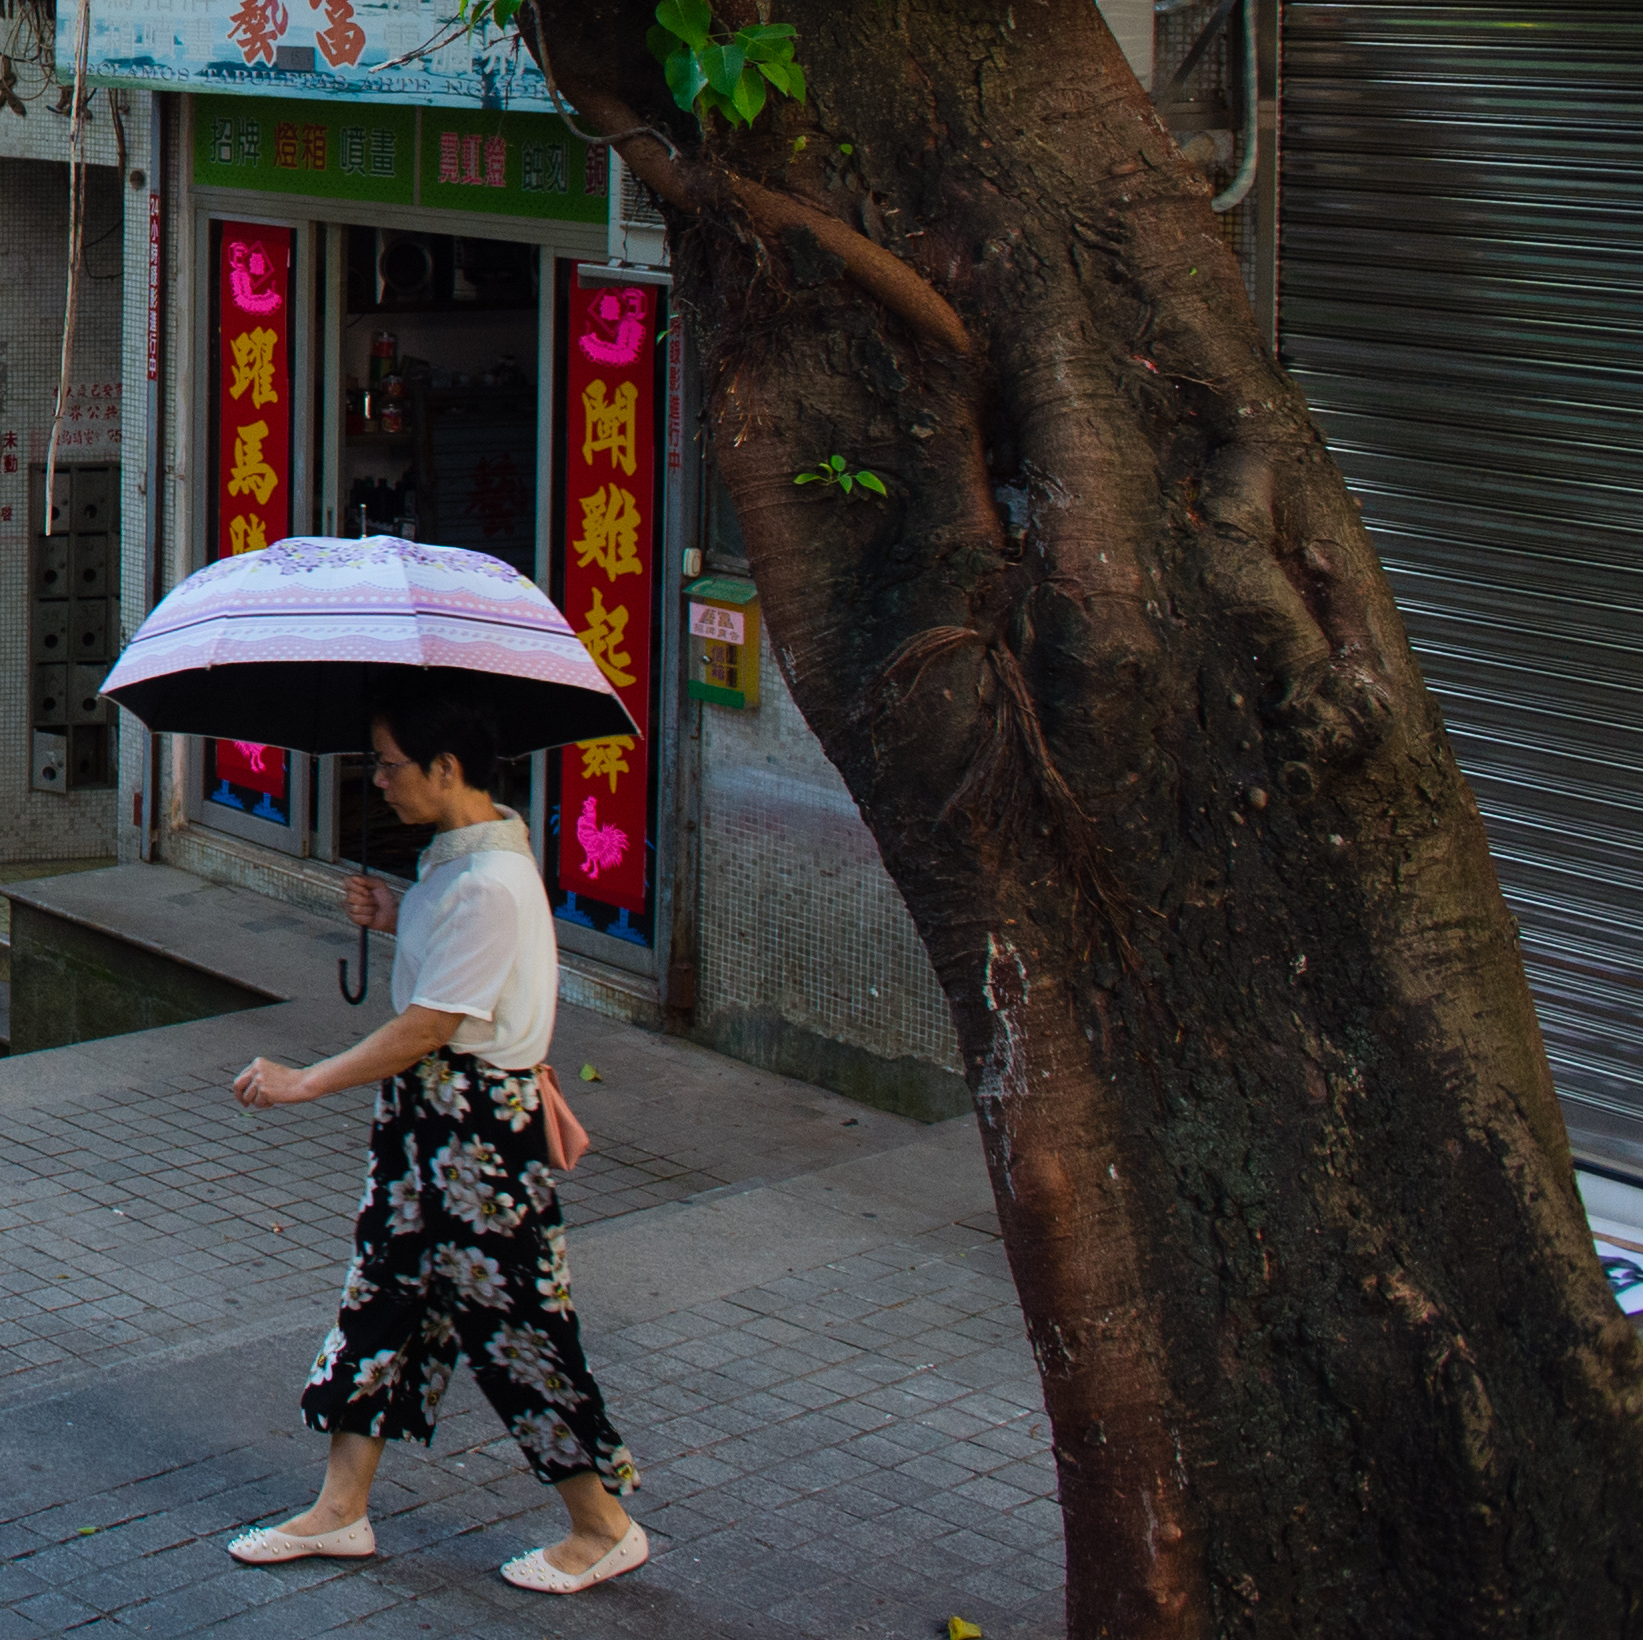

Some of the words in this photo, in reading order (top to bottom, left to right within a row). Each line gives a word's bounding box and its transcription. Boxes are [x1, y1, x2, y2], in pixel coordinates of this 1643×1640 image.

[209, 113, 263, 168] 招牌
[272, 120, 329, 172] 燈箱
[338, 125, 397, 179] 噴畫
[437, 131, 508, 188] 霓虹燈
